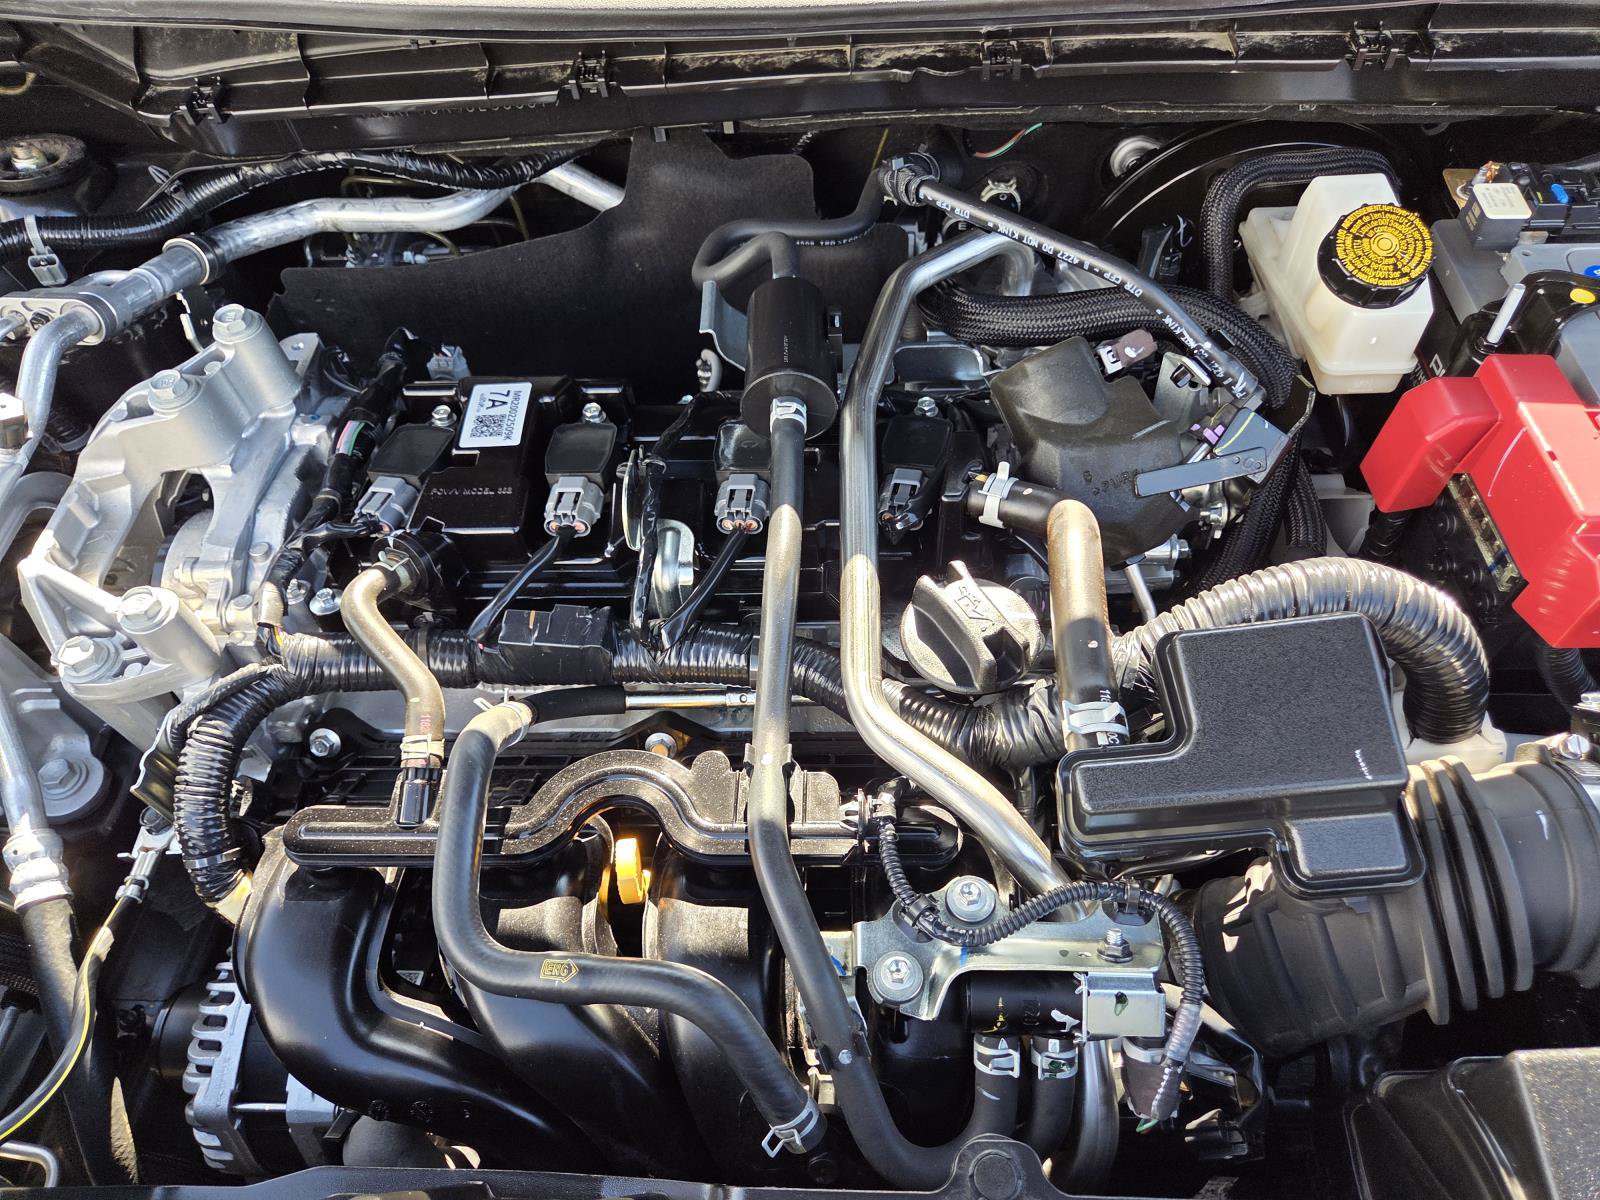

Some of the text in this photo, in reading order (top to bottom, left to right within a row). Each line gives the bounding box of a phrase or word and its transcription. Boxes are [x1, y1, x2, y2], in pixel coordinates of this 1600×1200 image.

[997, 223, 1020, 239] KINK
[1023, 235, 1040, 249] NOT
[486, 389, 511, 410] 7A
[544, 960, 569, 977] ENG
